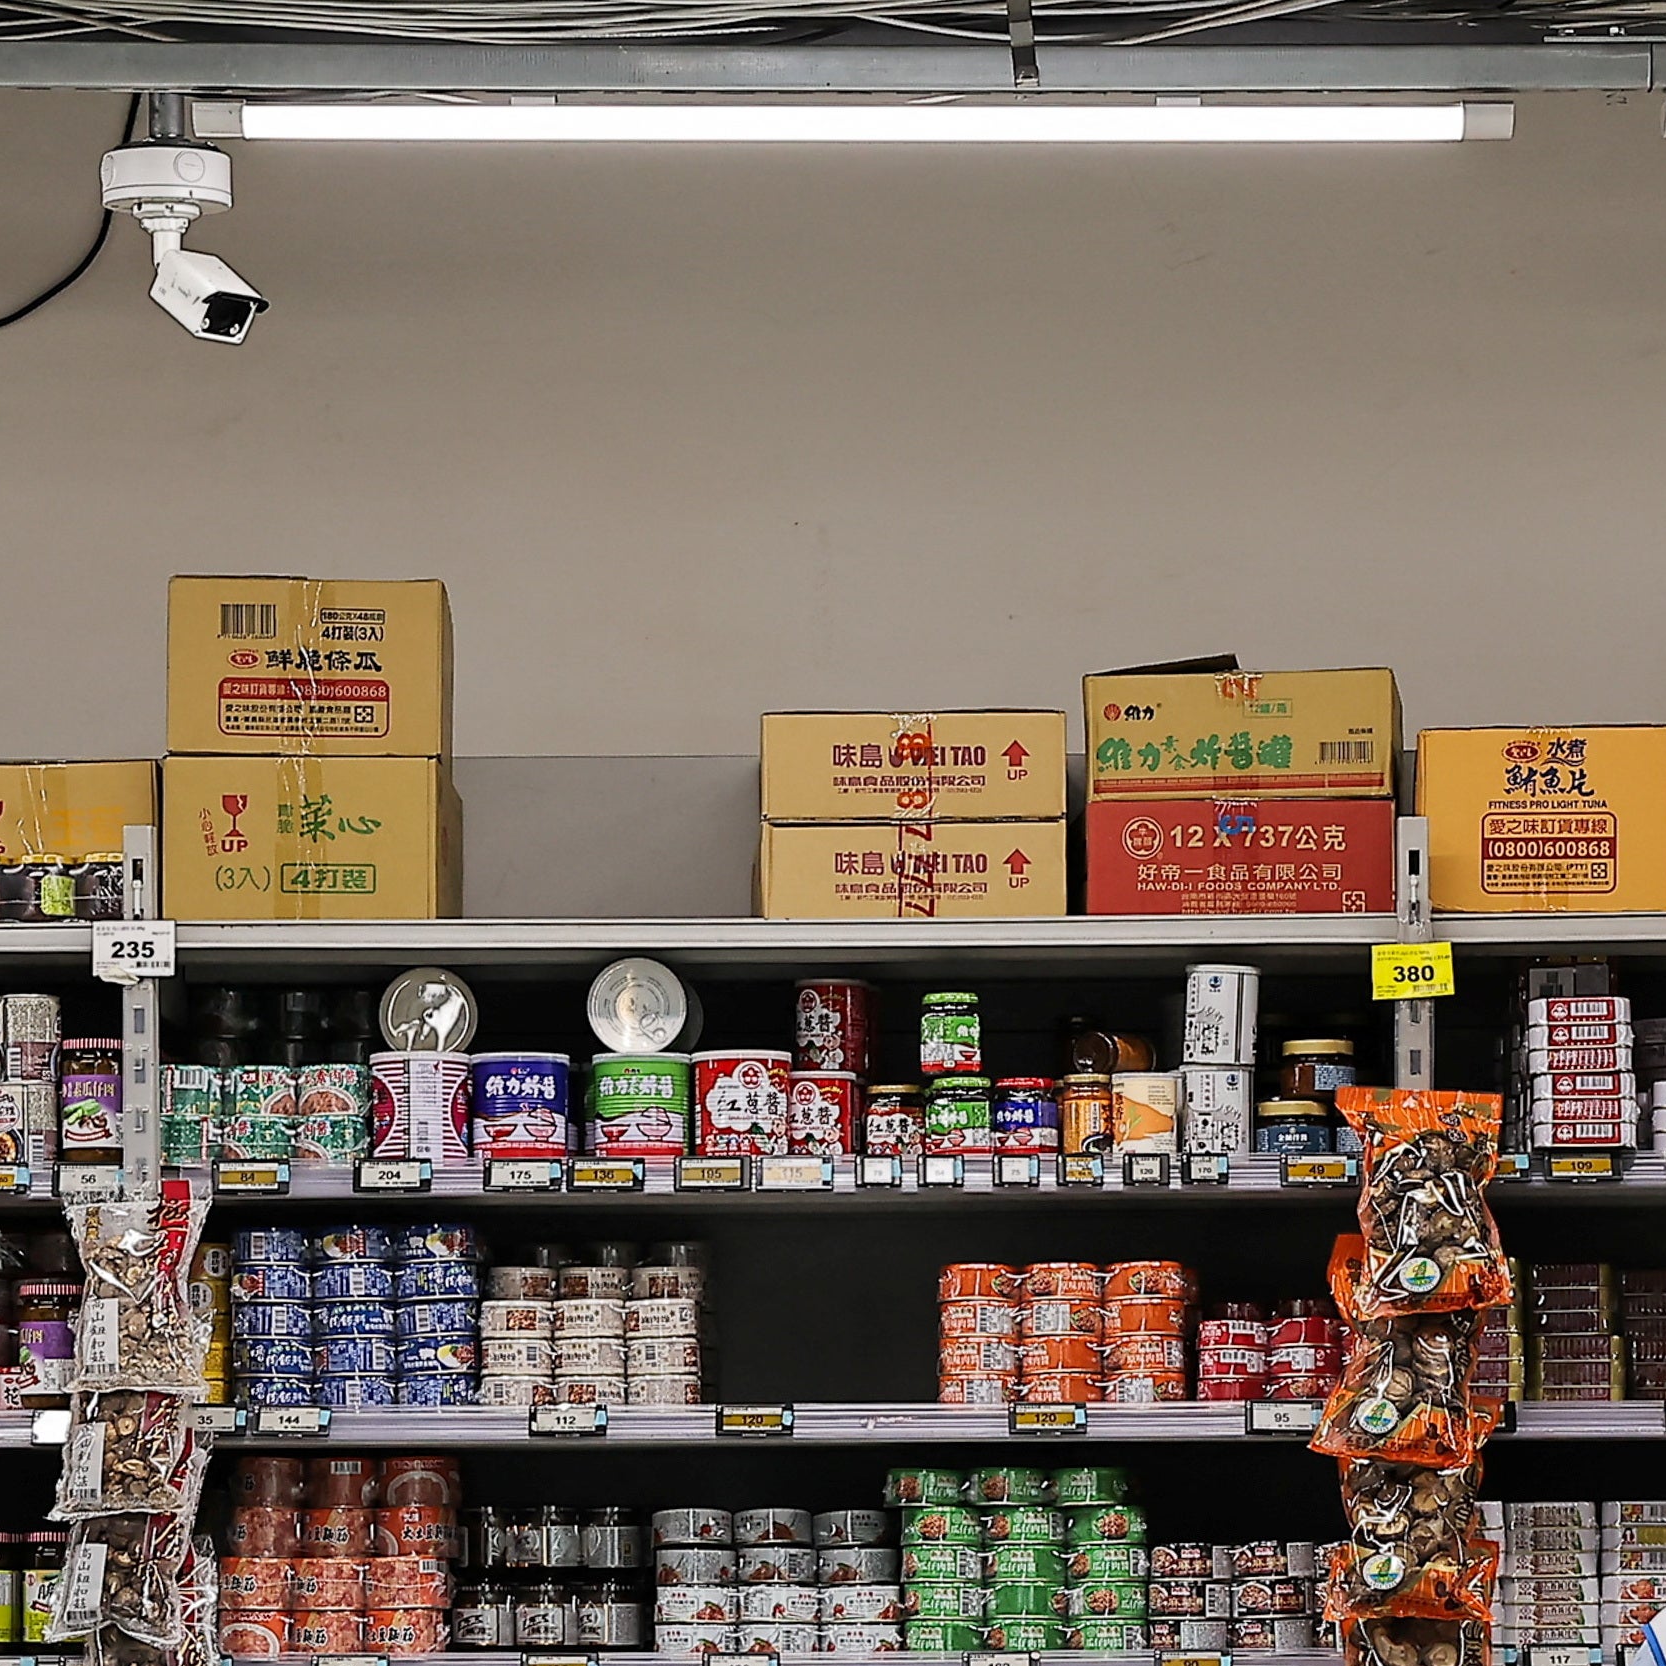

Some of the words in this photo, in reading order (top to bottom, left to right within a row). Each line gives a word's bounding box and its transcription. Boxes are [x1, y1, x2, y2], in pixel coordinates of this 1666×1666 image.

[265, 650, 383, 672] 鮮脆條瓜
[833, 744, 882, 768] 味島
[951, 746, 986, 766] TAO
[1546, 738, 1587, 760] 水煮
[1007, 769, 1028, 781] UP
[1503, 764, 1595, 797] 鮪魚片
[1488, 800, 1528, 809] FITNESS
[1529, 800, 1550, 809] PRO
[1551, 800, 1579, 809] LIGHT
[1582, 800, 1608, 809] TUNA
[1488, 818, 1608, 835] 愛之味訂貨專線
[219, 838, 250, 853] UP
[1170, 825, 1205, 849] 12
[1488, 840, 1611, 858] (0800)600868
[834, 852, 884, 876] 味島
[952, 854, 988, 874] TAO
[1137, 863, 1343, 881] 好帝一食品有限公司
[214, 865, 272, 893] (3入)
[290, 867, 368, 890] 4打裝
[1008, 877, 1030, 889] UP
[1197, 881, 1243, 891] FOODS
[1247, 881, 1311, 891] COMPANY
[1313, 881, 1342, 891] LTD.
[111, 941, 155, 959] 235
[1392, 965, 1435, 983] 380
[717, 1091, 781, 1117] 紅蔥醬
[868, 1117, 910, 1135] 紅蔥醬
[1309, 1164, 1325, 1176] 49
[1569, 1160, 1593, 1172] 109
[80, 1174, 97, 1185] 56
[378, 1169, 402, 1181] 204
[508, 1169, 532, 1181] 175
[277, 1415, 300, 1426] 144
[554, 1415, 577, 1426] 112
[740, 1414, 764, 1426] 120
[1033, 1412, 1056, 1424] 120
[1273, 1412, 1291, 1424] 95
[1549, 1654, 1572, 1665] 117
